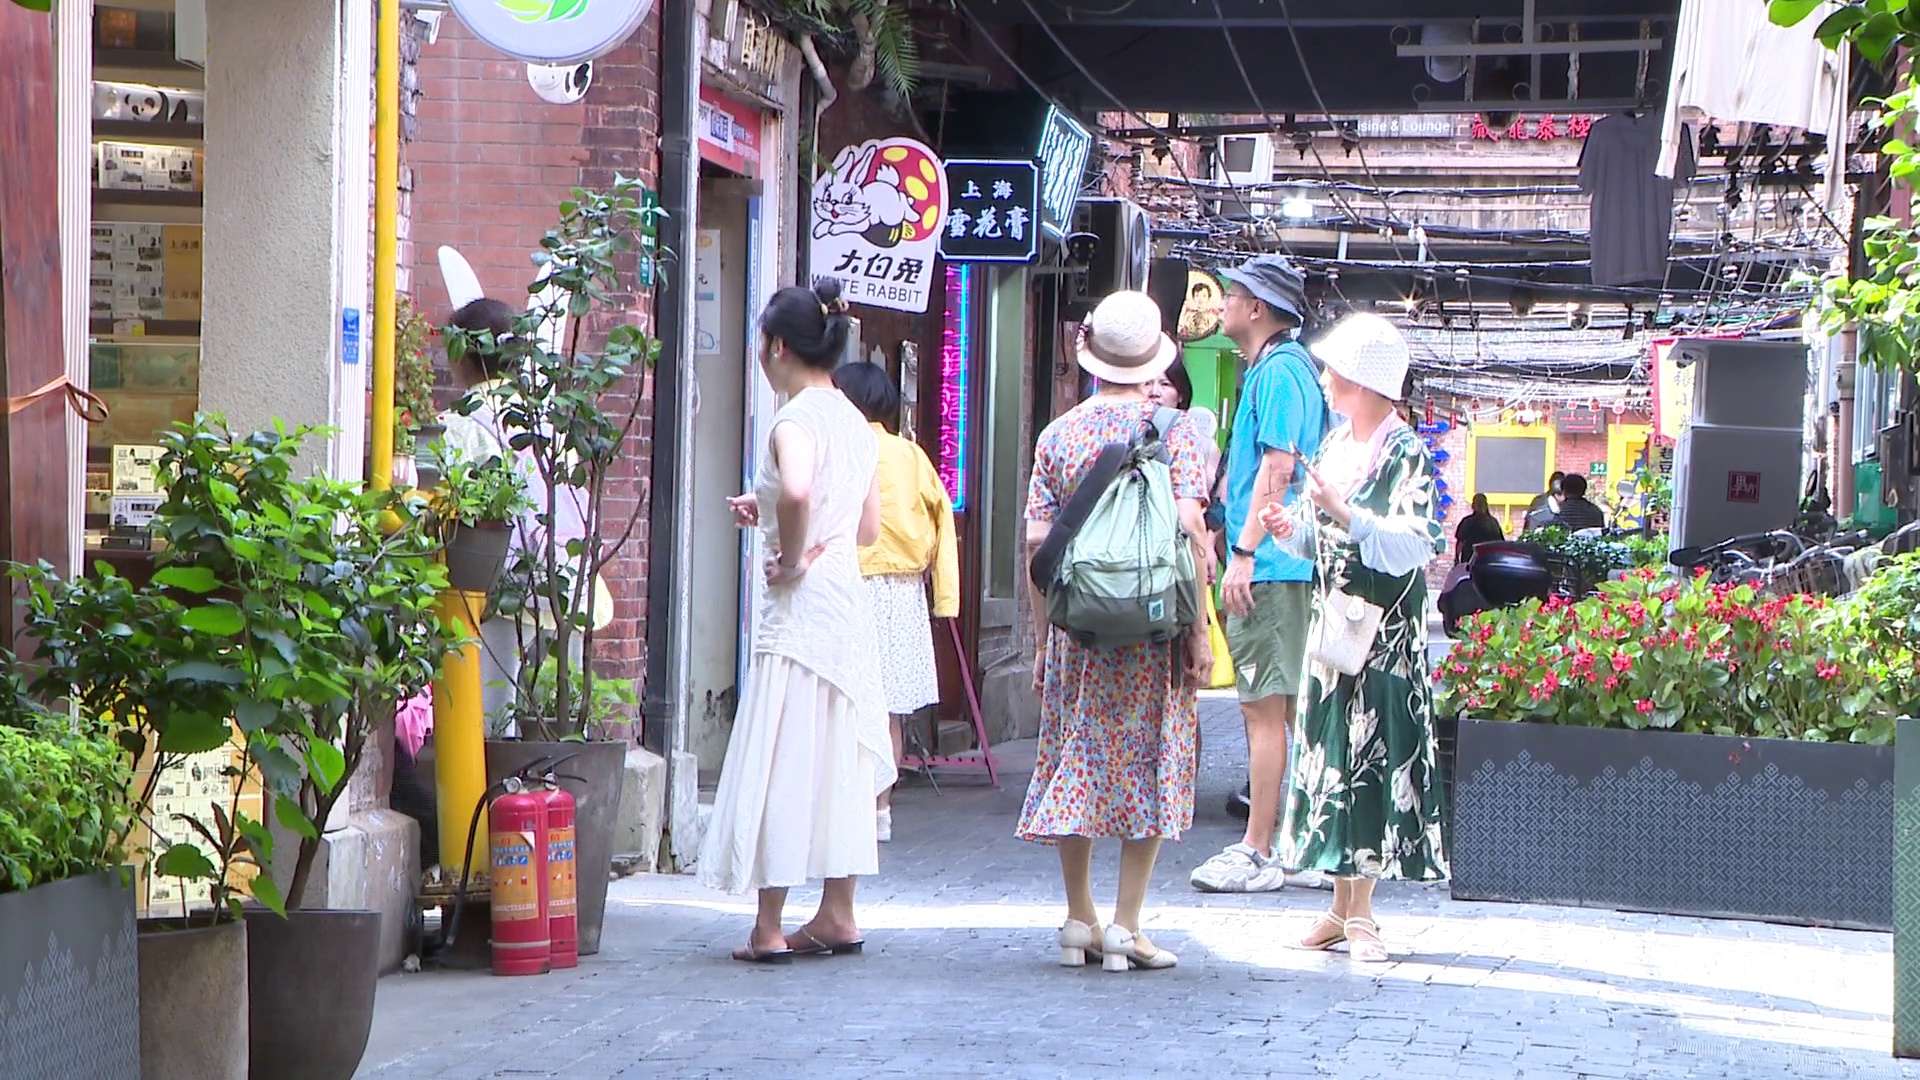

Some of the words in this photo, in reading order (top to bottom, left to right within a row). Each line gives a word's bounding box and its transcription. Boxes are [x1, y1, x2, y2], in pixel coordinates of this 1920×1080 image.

[1357, 119, 1387, 132] isine
[1390, 119, 1399, 132] &
[1402, 119, 1451, 134] Lounge
[961, 179, 1014, 200] 上海
[946, 205, 1030, 241] 雪花膏
[833, 249, 923, 285] 大白兔
[811, 273, 860, 295] WTE
[866, 283, 922, 304] RABBIT
